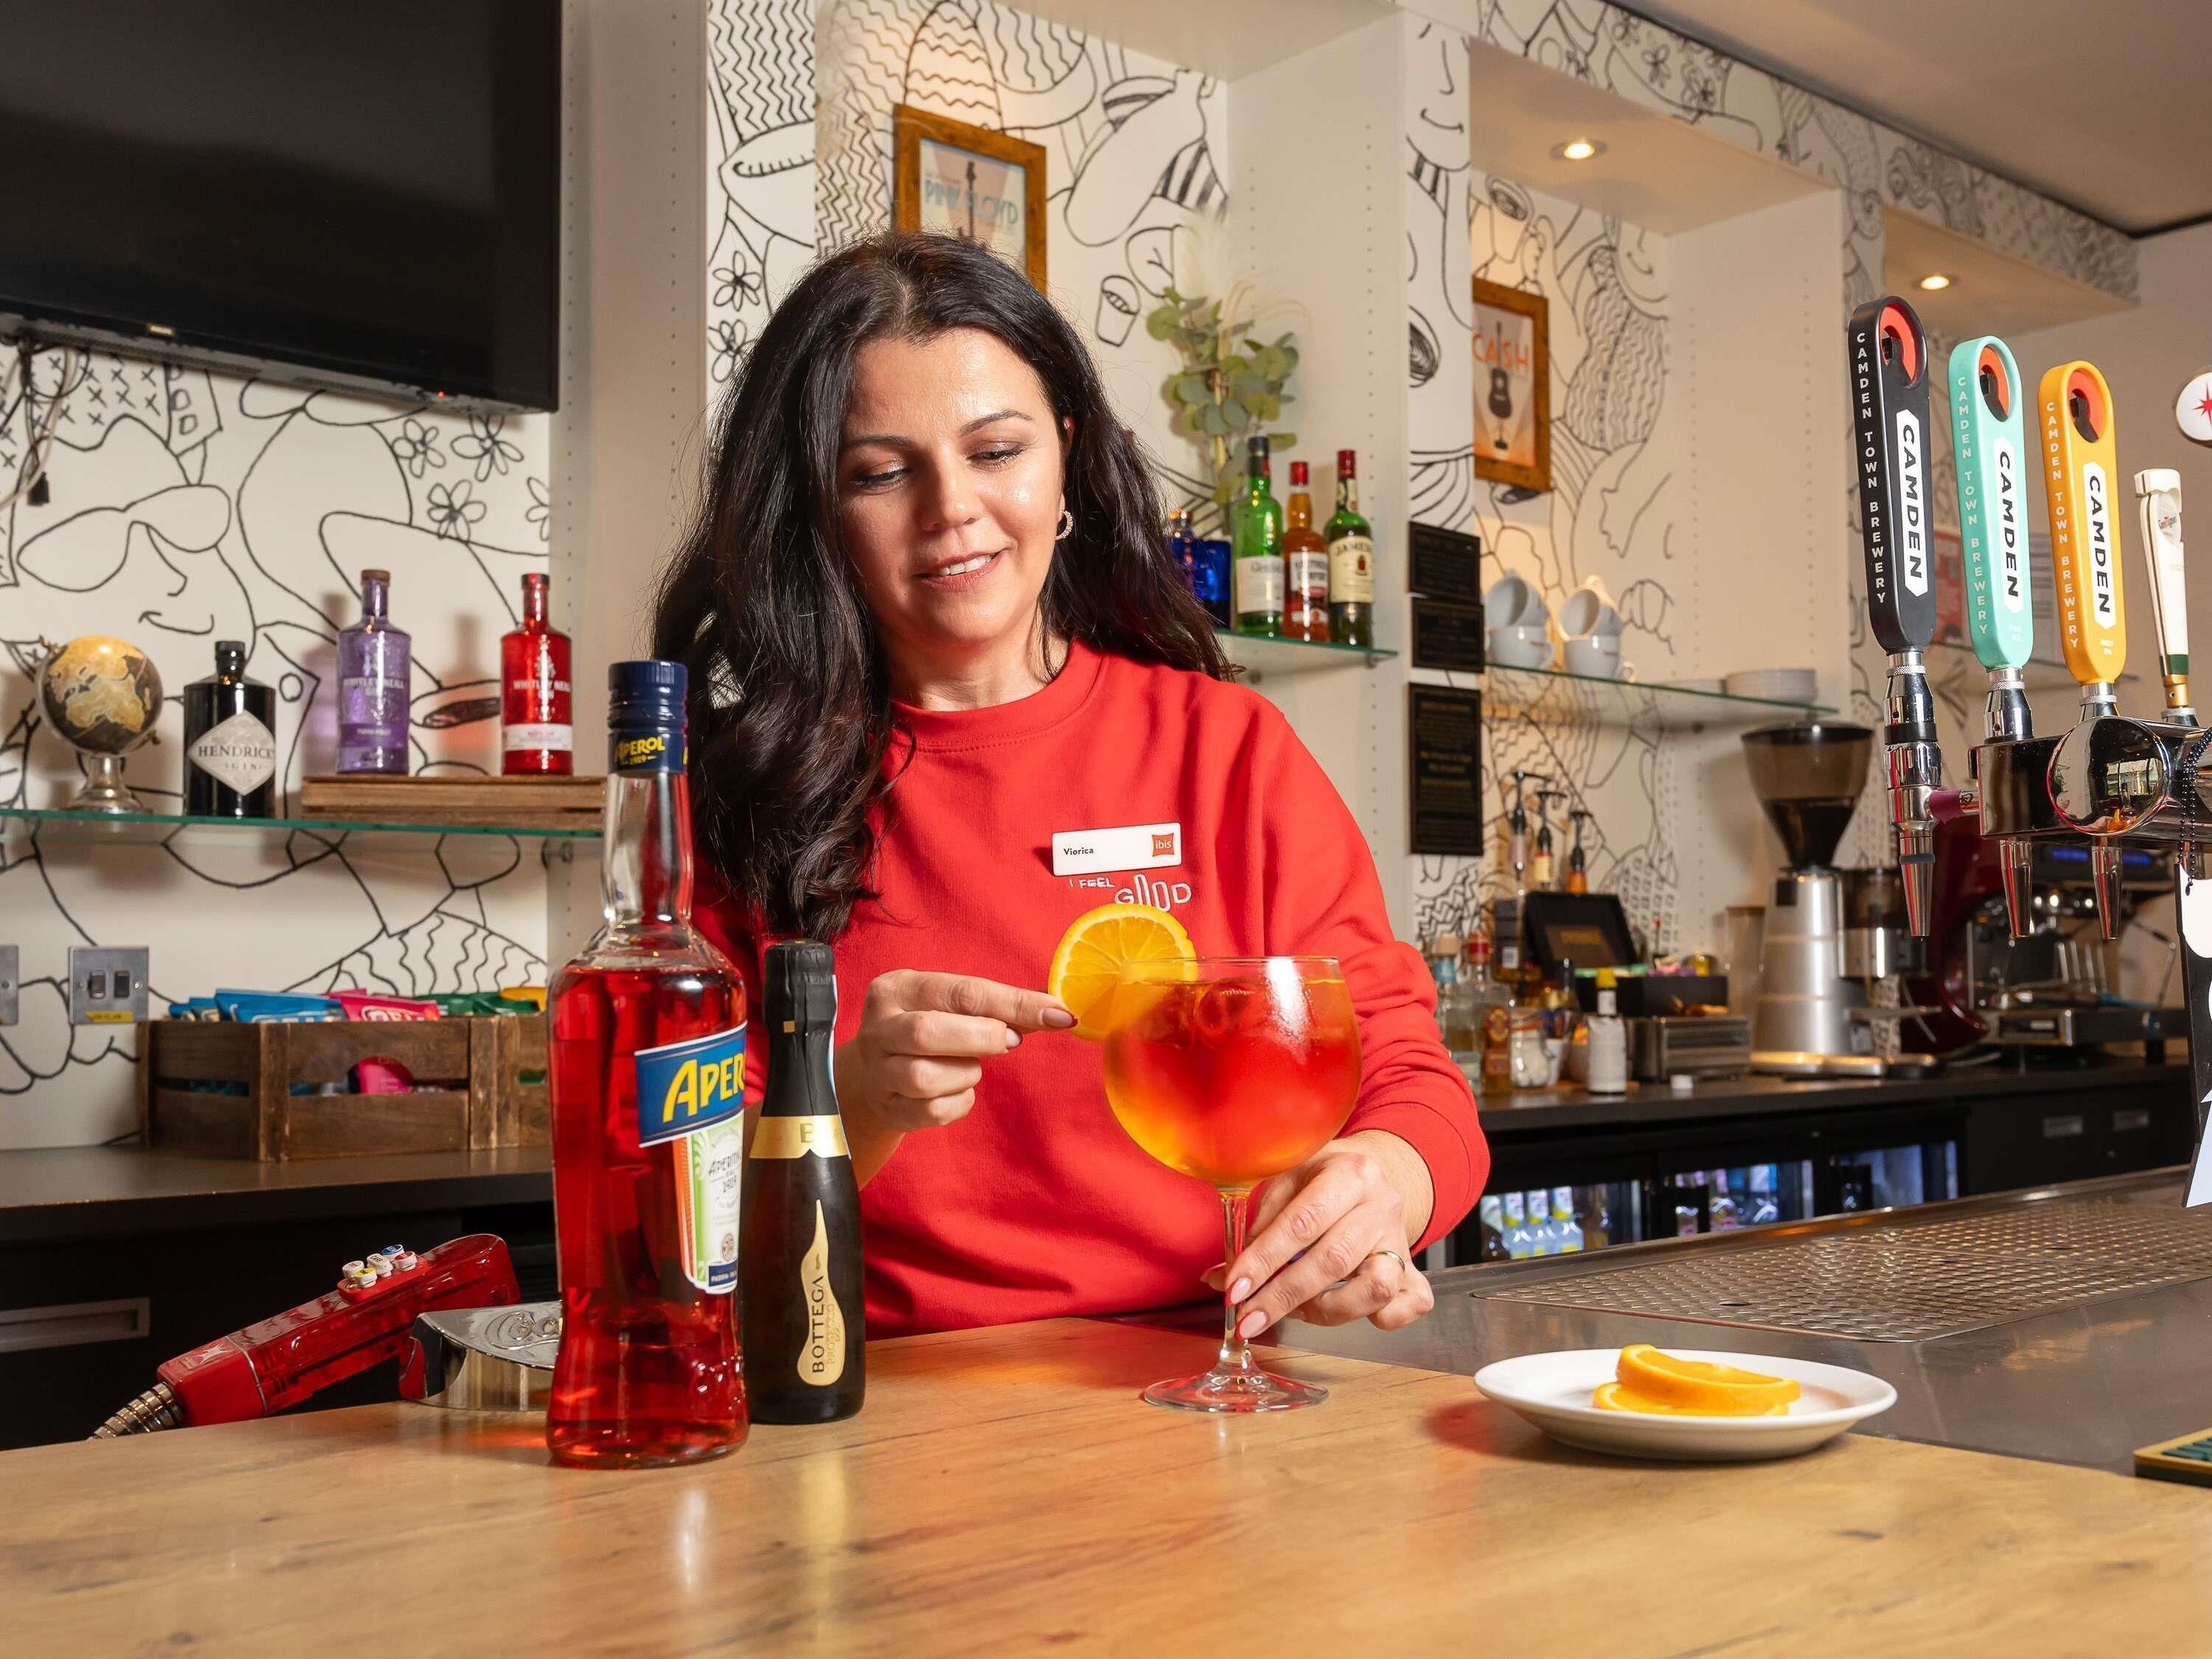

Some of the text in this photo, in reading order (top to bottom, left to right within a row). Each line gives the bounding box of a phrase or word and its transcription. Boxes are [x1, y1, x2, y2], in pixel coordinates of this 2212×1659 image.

[1472, 331, 1528, 375] CASH
[1856, 332, 1885, 603] CAMDEN TOWN BREWERY
[1902, 424, 1922, 578] CAMDEN
[1958, 377, 1989, 634] CAMDEN TOWN BREWERY
[1999, 451, 2019, 597] CAMDEN
[2046, 402, 2079, 647] CAMDEN TOWN BREWERY
[2089, 475, 2110, 613] CAMDEN
[614, 737, 666, 763] APEROL
[1063, 847, 1094, 855] Viorica
[1079, 877, 1116, 889] FEEL
[1114, 874, 1192, 912] GOOD
[1155, 840, 1172, 849] ibis
[812, 1275, 825, 1373] BOTTEGA
